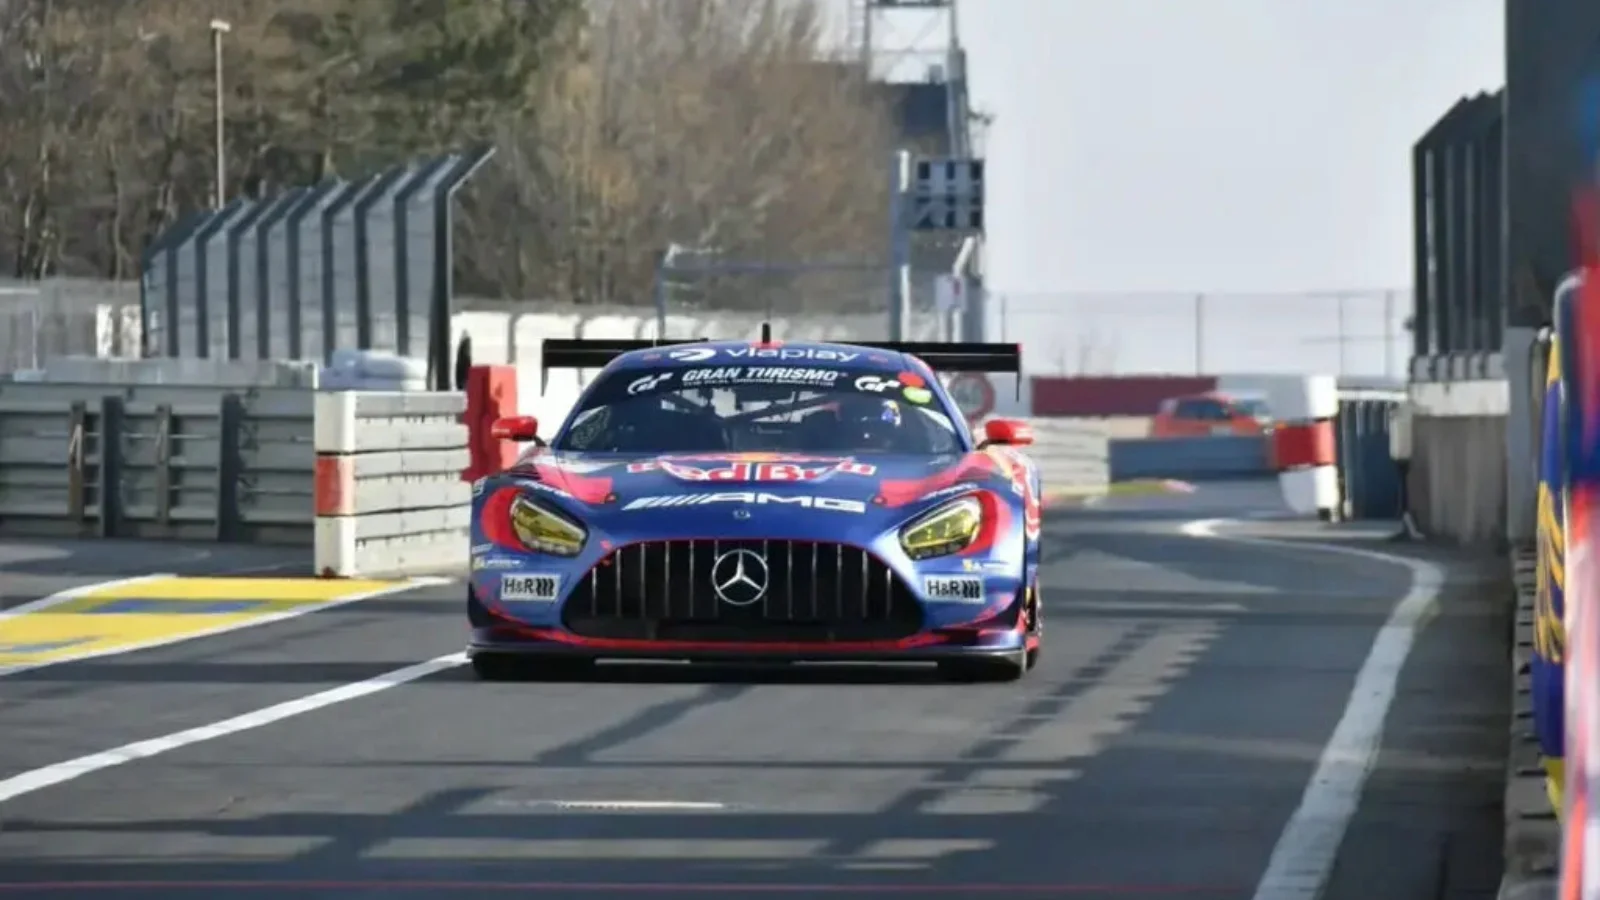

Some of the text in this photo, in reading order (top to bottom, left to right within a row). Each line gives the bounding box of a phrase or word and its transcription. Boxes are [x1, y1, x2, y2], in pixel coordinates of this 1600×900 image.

[726, 348, 860, 362] viaplay
[682, 367, 741, 382] GRAN
[704, 492, 866, 513] AMG
[504, 578, 534, 593] H&R
[927, 580, 961, 596] H&R
